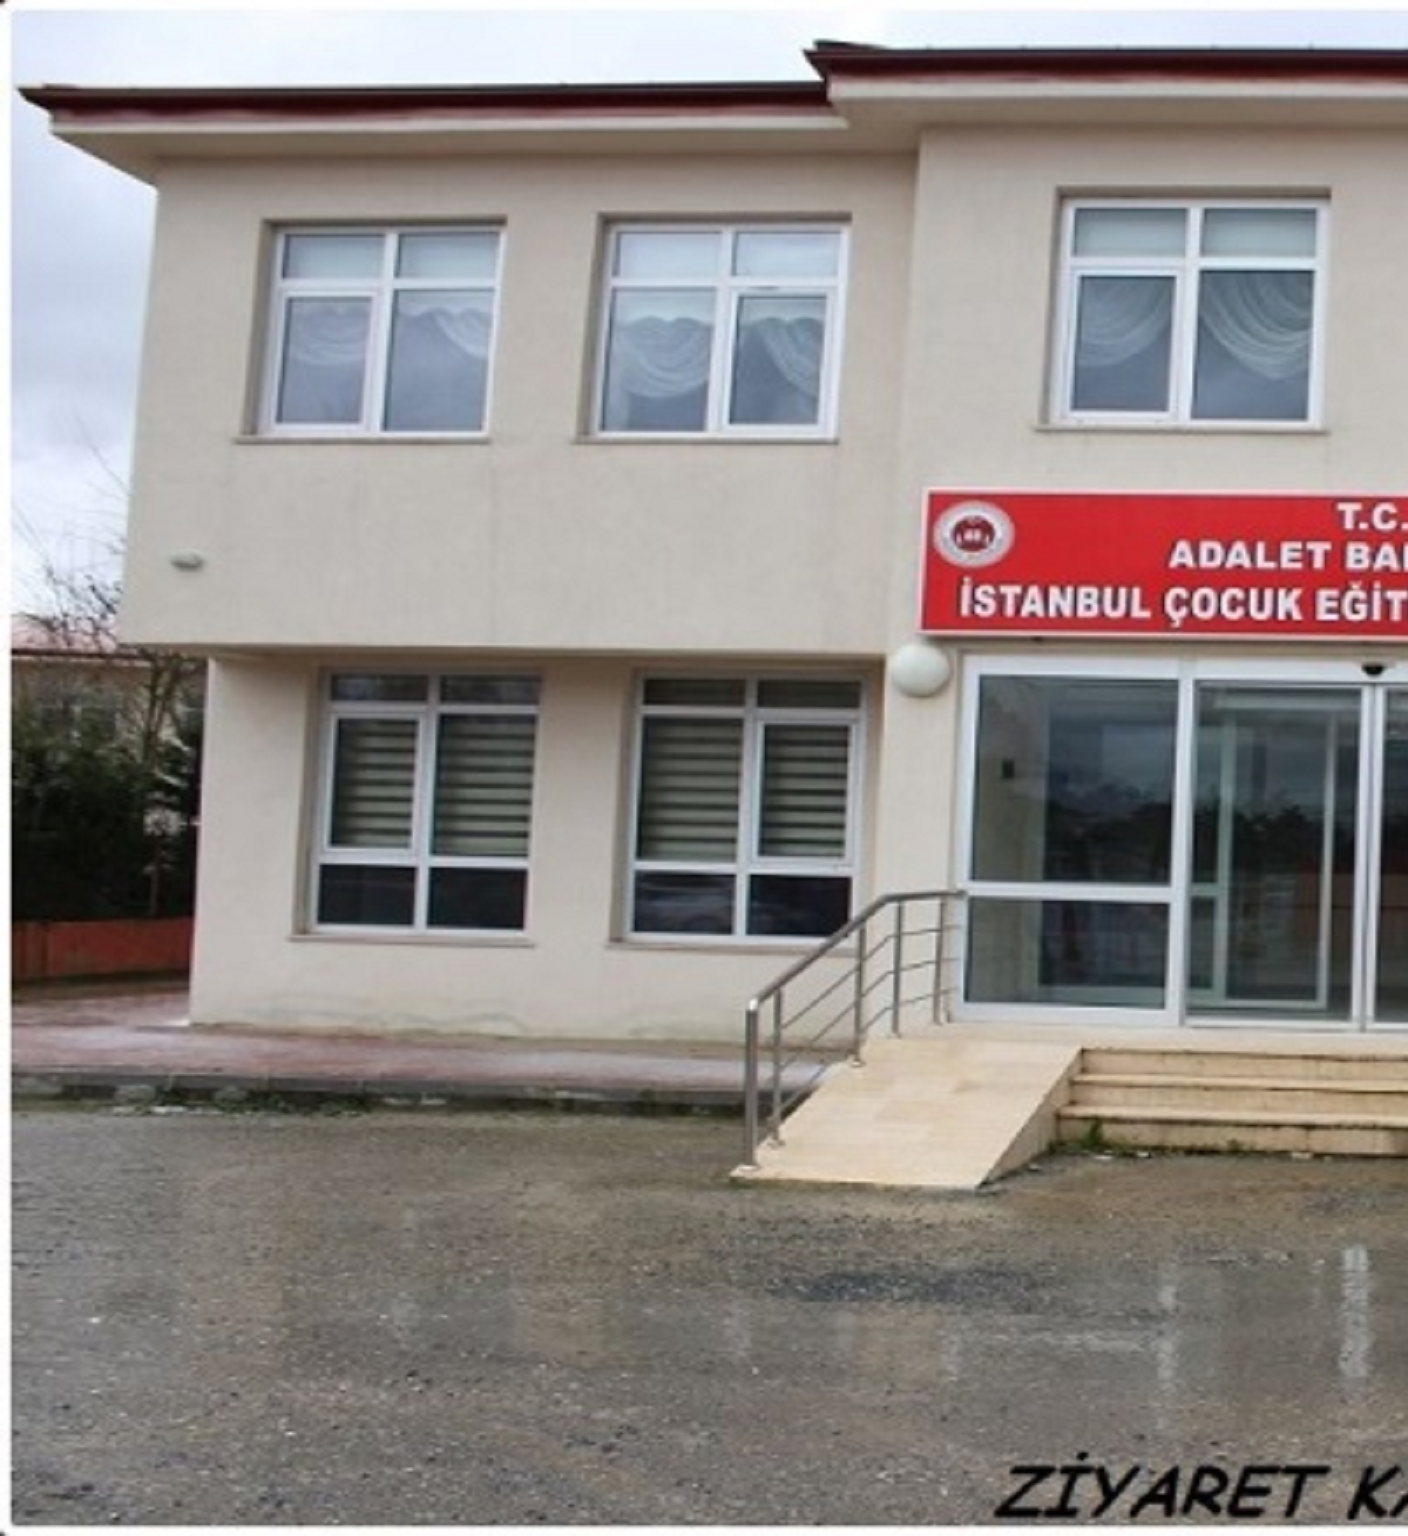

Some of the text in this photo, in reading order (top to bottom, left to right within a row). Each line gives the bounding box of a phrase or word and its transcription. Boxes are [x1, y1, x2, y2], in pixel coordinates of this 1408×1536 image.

[1169, 540, 1332, 569] ADALET
[960, 576, 1151, 619] İSTANBUL
[1164, 586, 1303, 628] ÇOCUK
